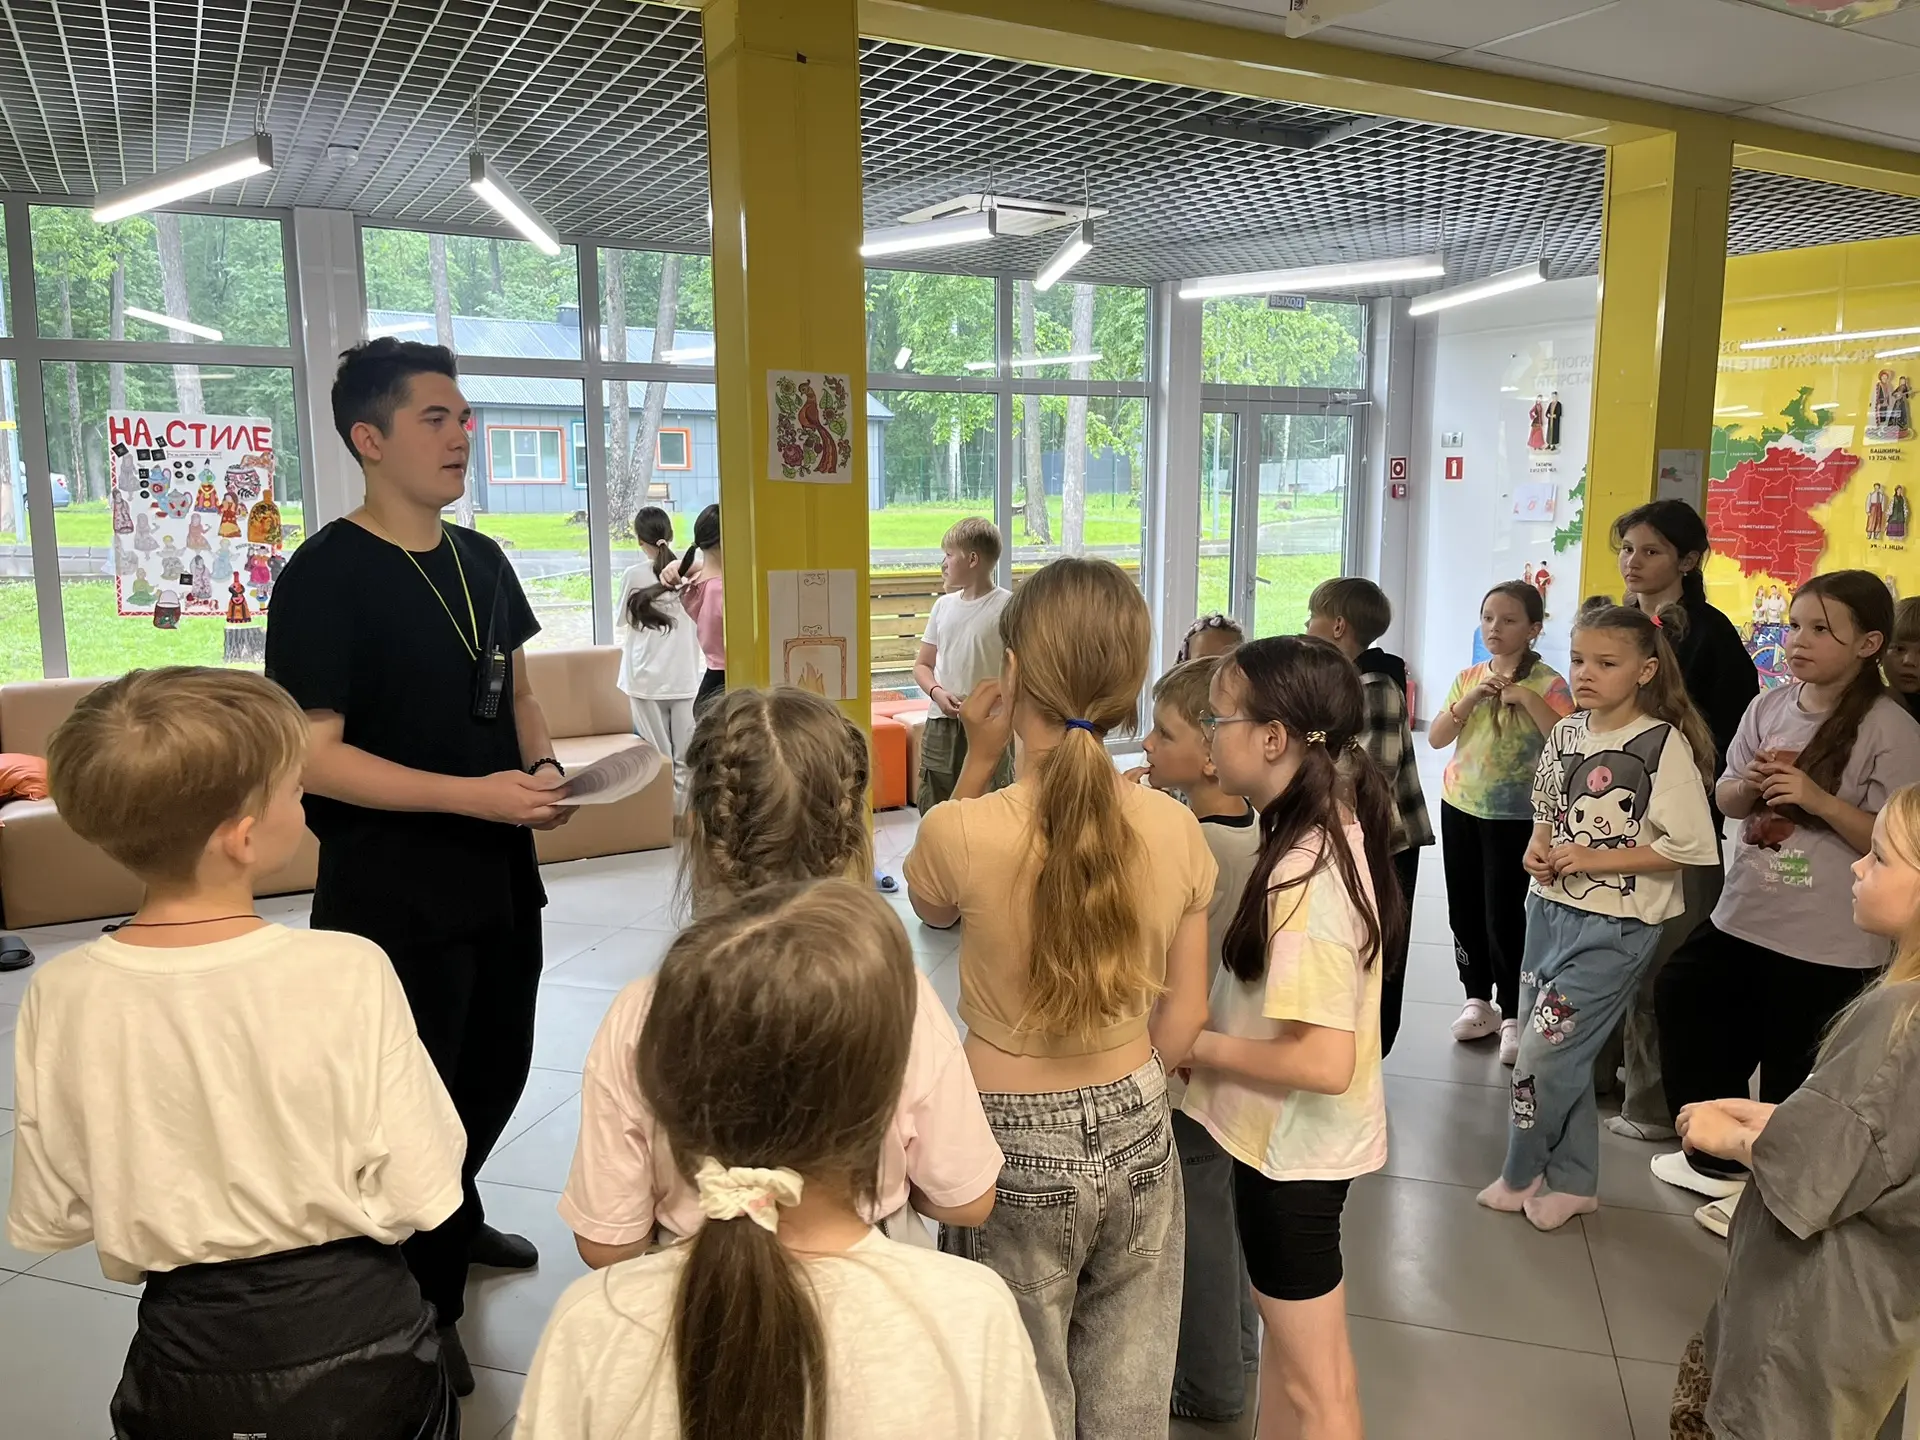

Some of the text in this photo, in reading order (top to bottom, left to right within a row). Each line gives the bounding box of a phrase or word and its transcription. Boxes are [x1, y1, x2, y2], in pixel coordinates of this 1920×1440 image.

[1271, 295, 1303, 308] ВЫХОД
[109, 416, 273, 451] НА СТИЛЕ
